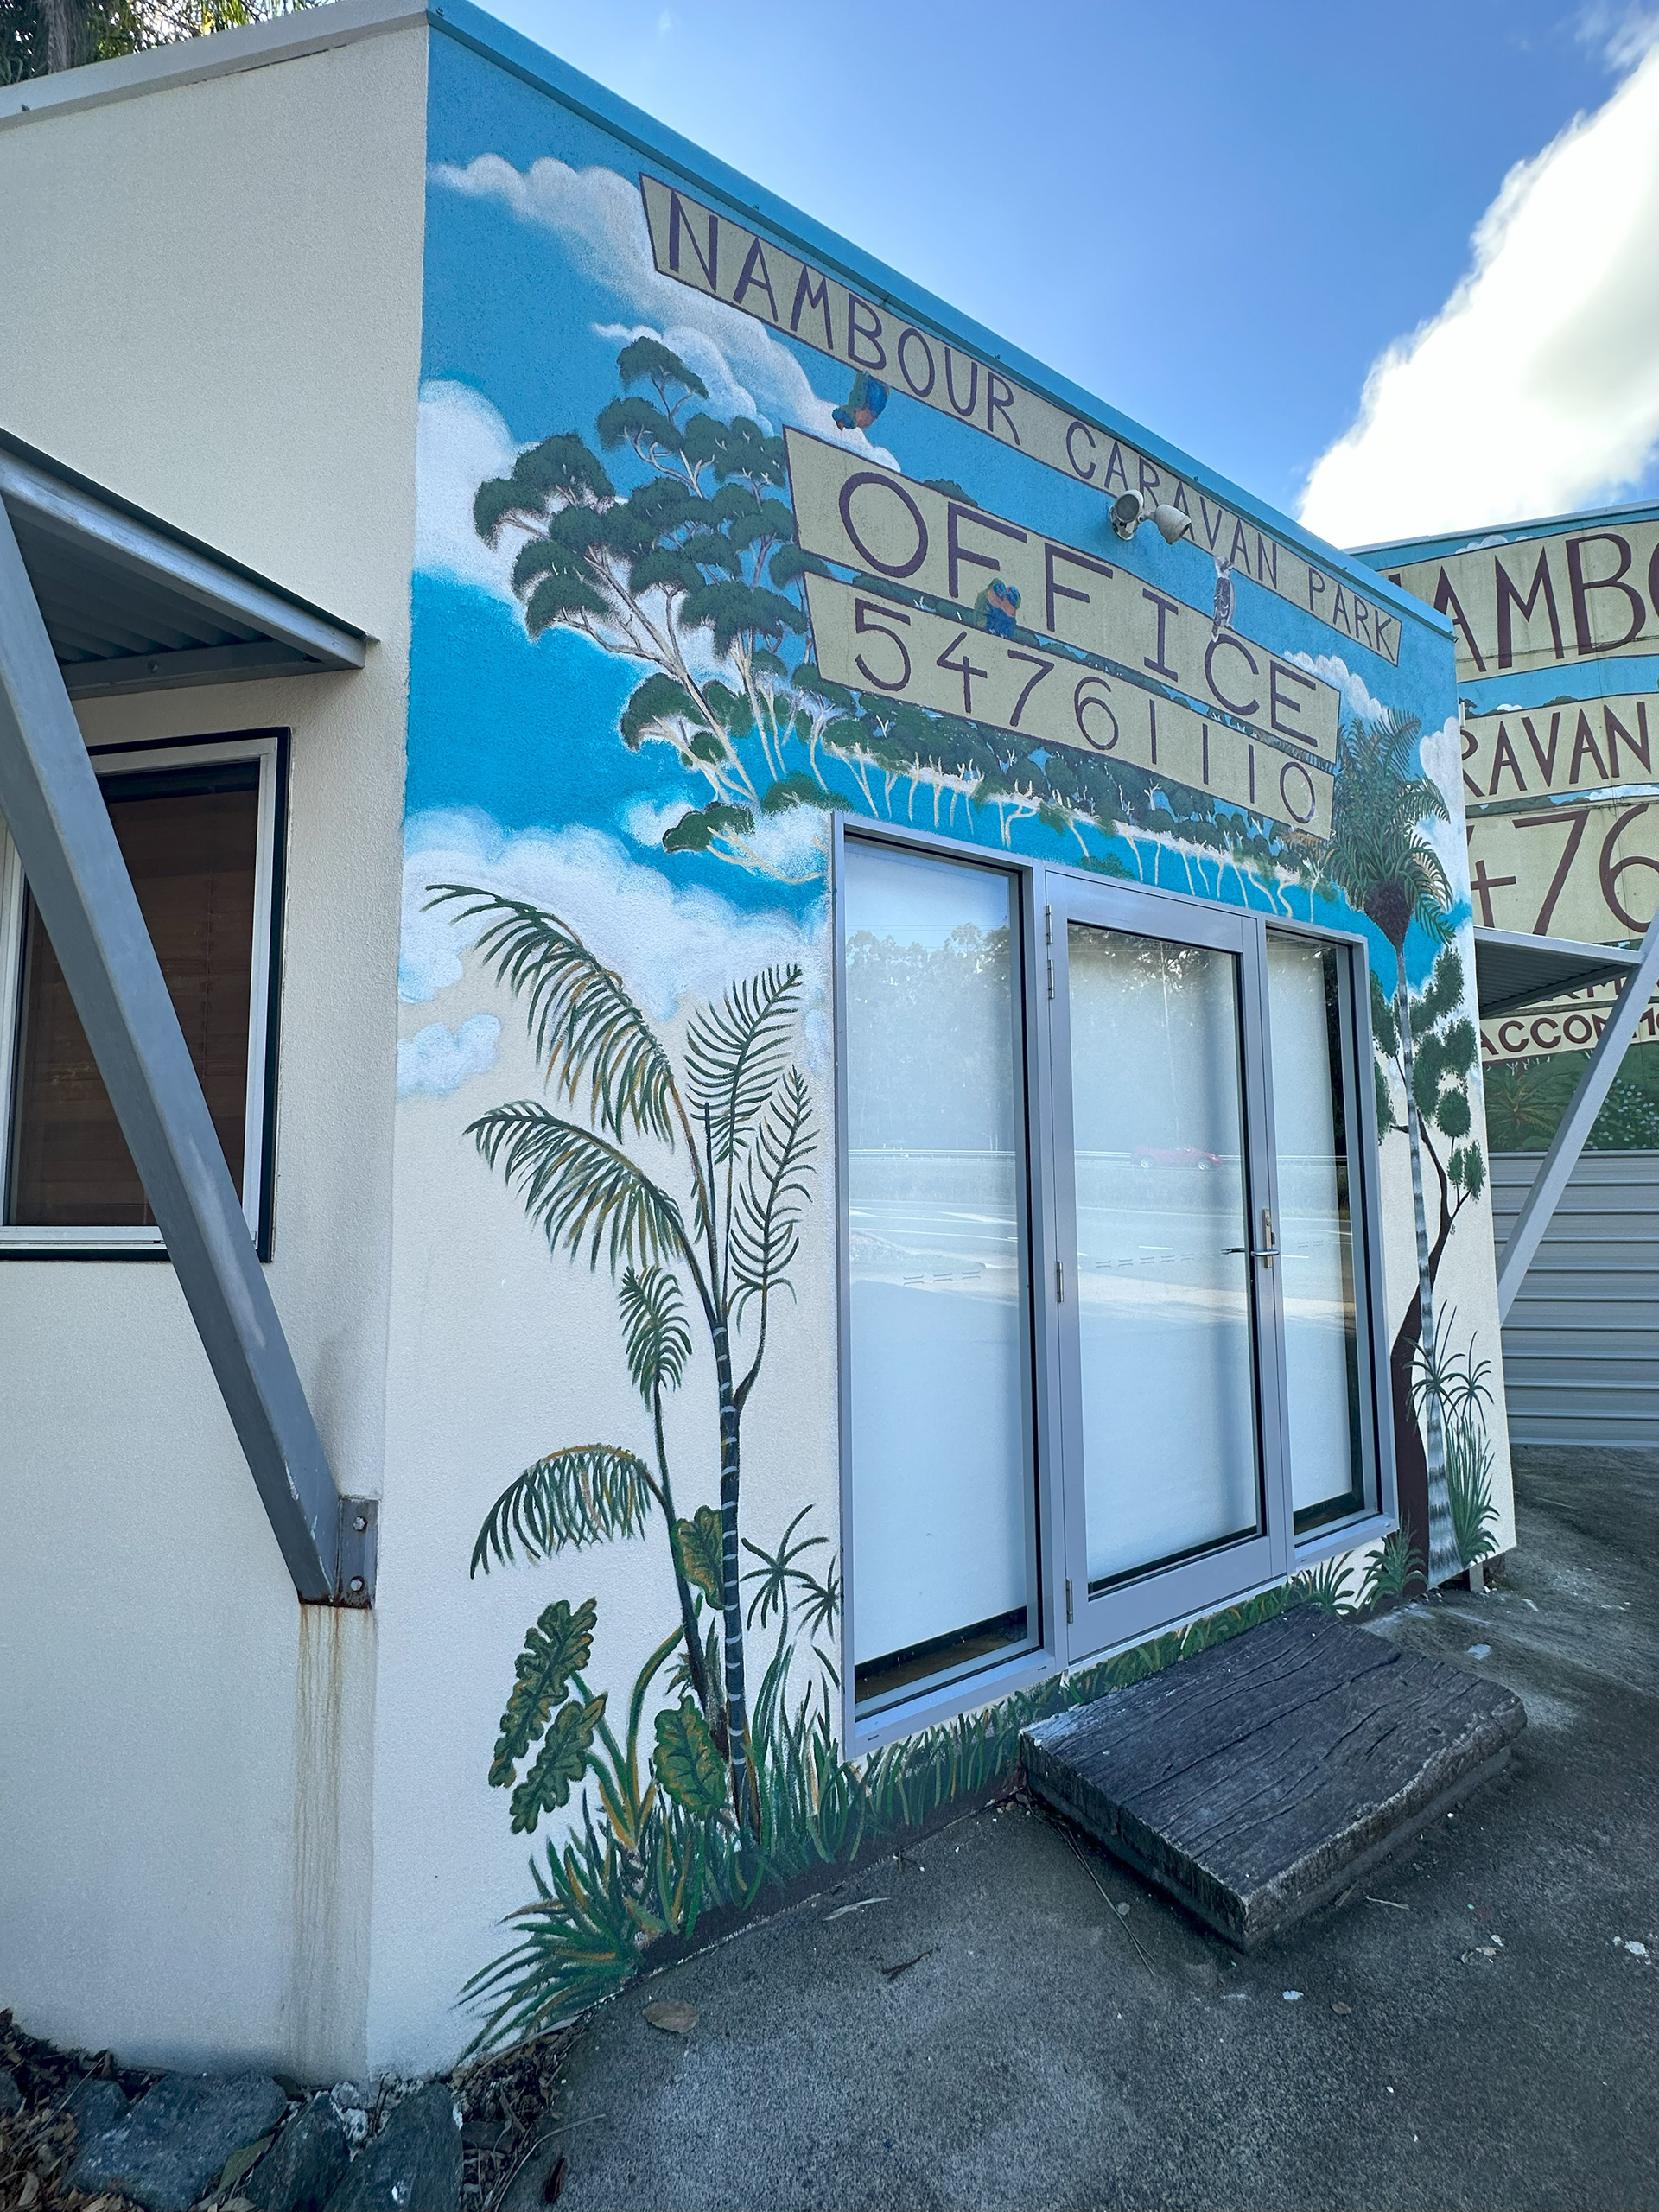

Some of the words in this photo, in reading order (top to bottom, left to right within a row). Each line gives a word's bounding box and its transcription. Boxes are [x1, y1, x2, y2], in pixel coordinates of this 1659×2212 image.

[669, 188, 1021, 446] NAMBOUR
[1065, 420, 1278, 590] CARAVAN
[1308, 566, 1395, 662] PARK
[838, 471, 1319, 748] OFFICE
[854, 598, 1316, 824] 54761110
[1388, 532, 1659, 672] AMB
